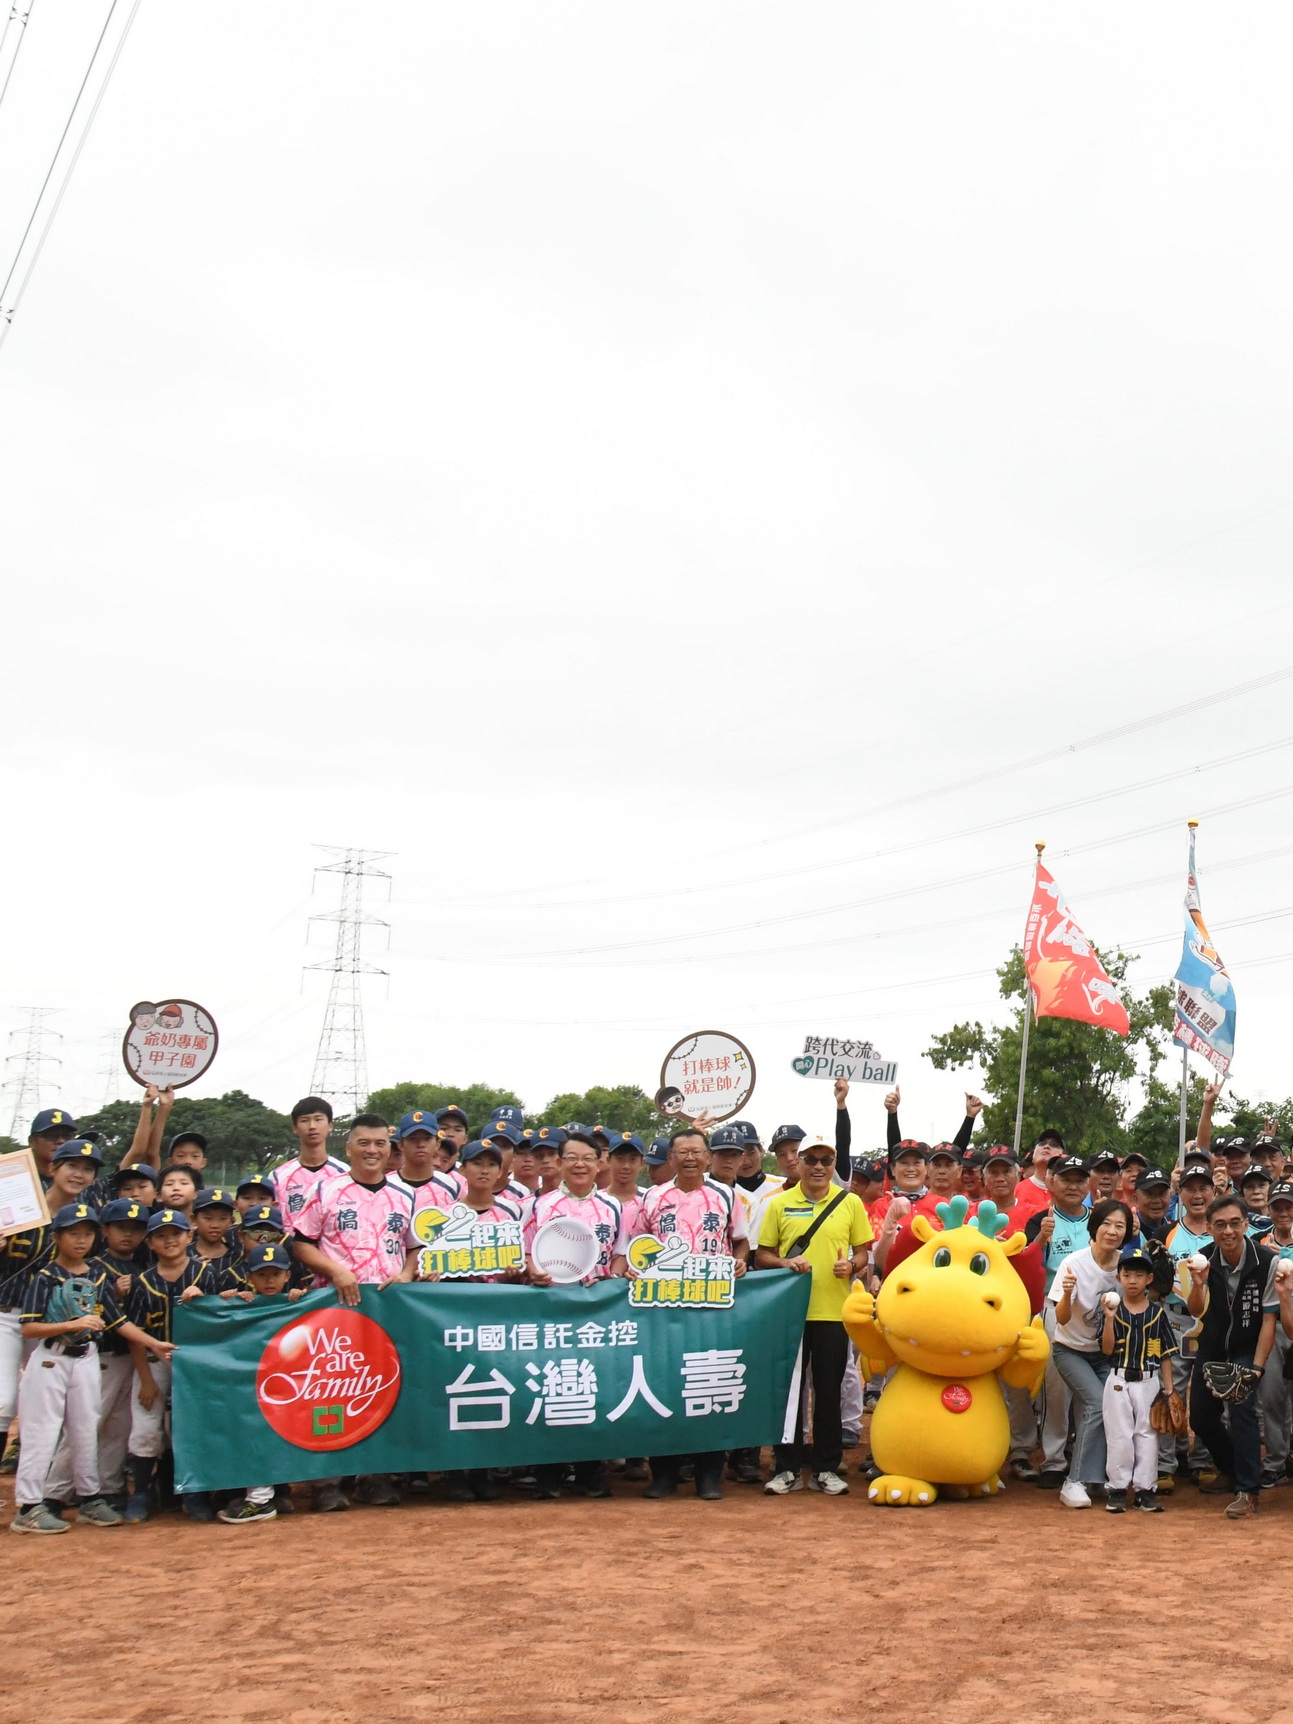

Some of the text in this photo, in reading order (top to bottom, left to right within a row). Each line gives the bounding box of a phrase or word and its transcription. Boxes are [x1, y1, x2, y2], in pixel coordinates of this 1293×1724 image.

[143, 1031, 208, 1051] 爺奶專屬
[803, 1036, 874, 1060] 跨代交流
[149, 1050, 197, 1068] 甲子園
[682, 1056, 731, 1077] 打棒球
[815, 1057, 897, 1083] Play ball
[684, 1076, 742, 1096] 就是帥!
[337, 1208, 404, 1234] 僑 泰
[594, 1222, 611, 1244] 泰
[660, 1212, 720, 1234] 僑 泰
[386, 1239, 400, 1255] 30
[446, 1222, 521, 1249] 一起來
[702, 1238, 717, 1253] 19
[421, 1246, 522, 1275] 打棒球吧
[658, 1255, 732, 1280] 一起來
[632, 1277, 731, 1303] 打棒球吧
[302, 1327, 352, 1355] We
[443, 1320, 640, 1353] 中國信託金控
[326, 1351, 365, 1373] are
[446, 1348, 748, 1432] 台灣人壽
